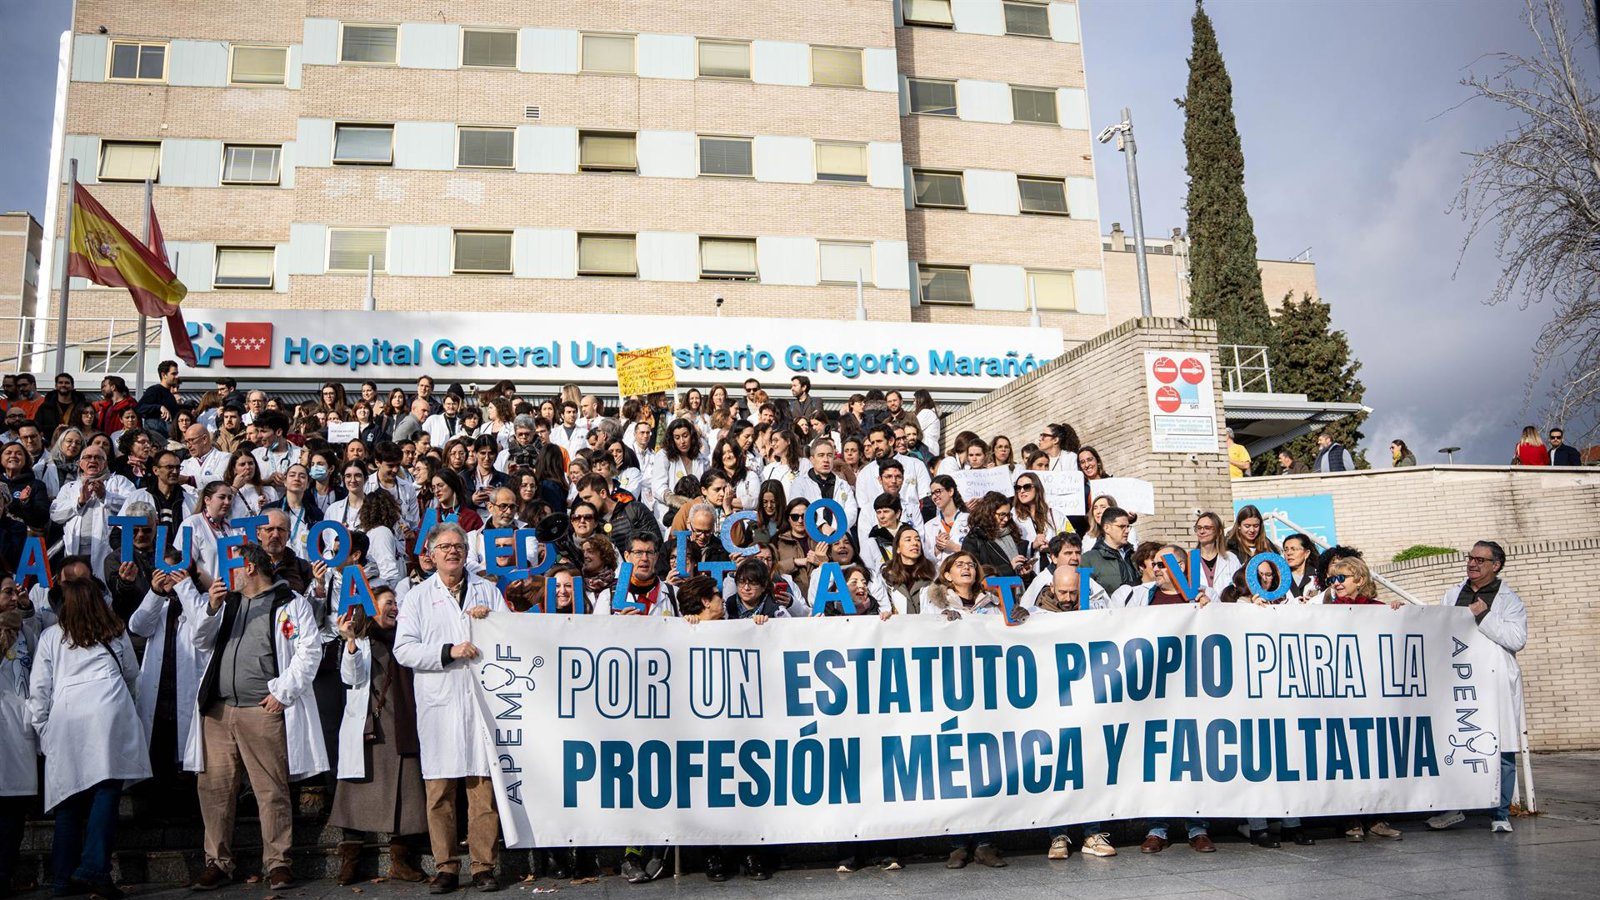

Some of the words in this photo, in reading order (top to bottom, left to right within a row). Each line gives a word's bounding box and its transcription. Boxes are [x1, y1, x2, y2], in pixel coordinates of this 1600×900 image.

[284, 337, 421, 371] Hospital
[431, 338, 560, 368] General
[784, 344, 919, 378] Gregorio
[108, 516, 149, 562] T
[307, 520, 352, 567] O
[721, 511, 760, 556] C
[805, 498, 847, 543] O
[15, 536, 54, 588] A
[155, 526, 193, 575] U
[217, 534, 249, 591] F
[483, 528, 514, 575] E
[1161, 550, 1200, 601] V
[338, 564, 381, 618] A
[613, 562, 645, 613] L
[812, 562, 857, 616] A
[981, 576, 1023, 626] T
[1245, 552, 1292, 600] O
[558, 646, 671, 719] POR
[690, 647, 764, 719] UN
[783, 644, 1038, 717] ESTATUTO
[1055, 633, 1233, 707] PROPIO
[1245, 633, 1367, 699] PARA
[1378, 633, 1428, 698] LA
[563, 719, 861, 809] PROFESIÓN
[881, 715, 1085, 802] MÉDICA
[1103, 722, 1130, 786] Y
[1143, 715, 1440, 783] FACULTATIVA
